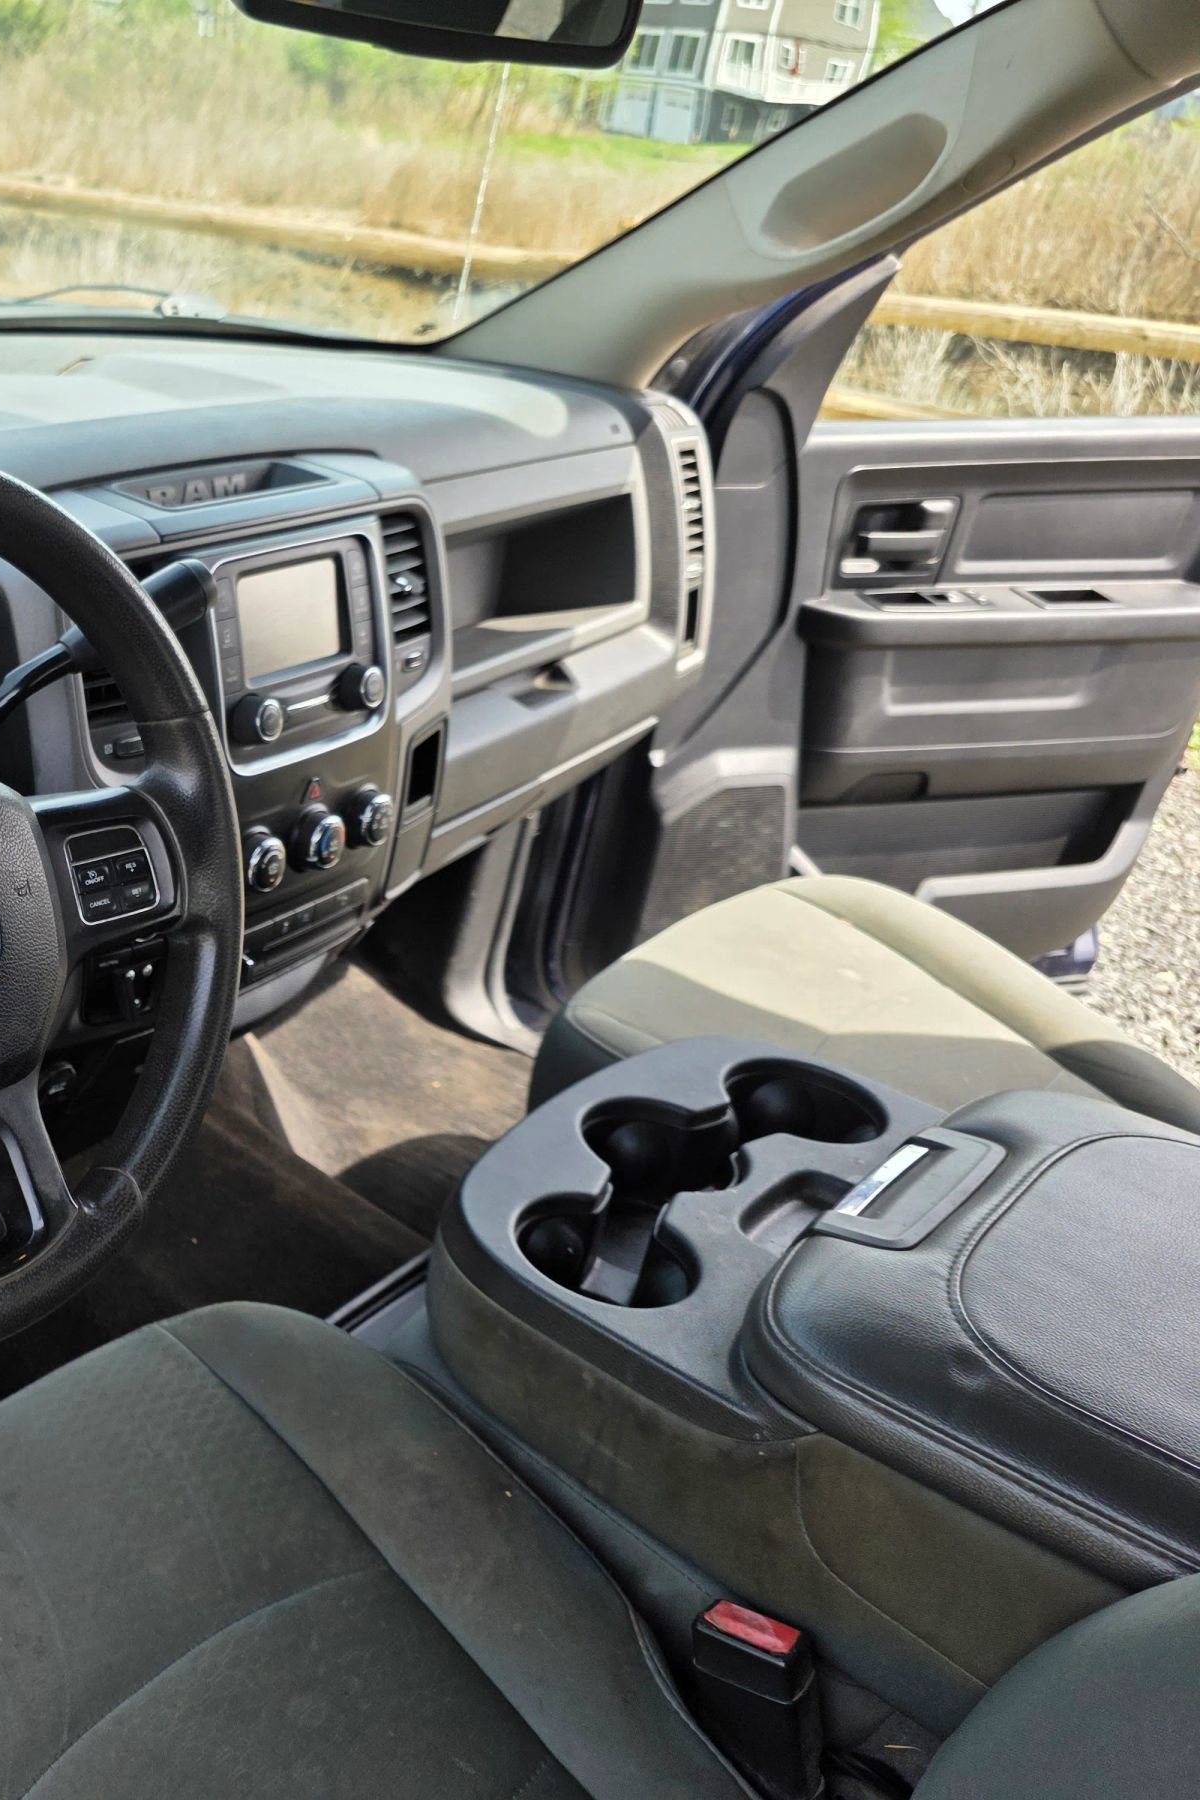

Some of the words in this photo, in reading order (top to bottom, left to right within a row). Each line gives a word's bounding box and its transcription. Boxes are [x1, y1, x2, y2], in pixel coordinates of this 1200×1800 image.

[148, 473, 247, 505] RAM
[85, 875, 104, 885] ON/OFF
[131, 887, 141, 895] SET
[89, 898, 110, 908] CANCEL
